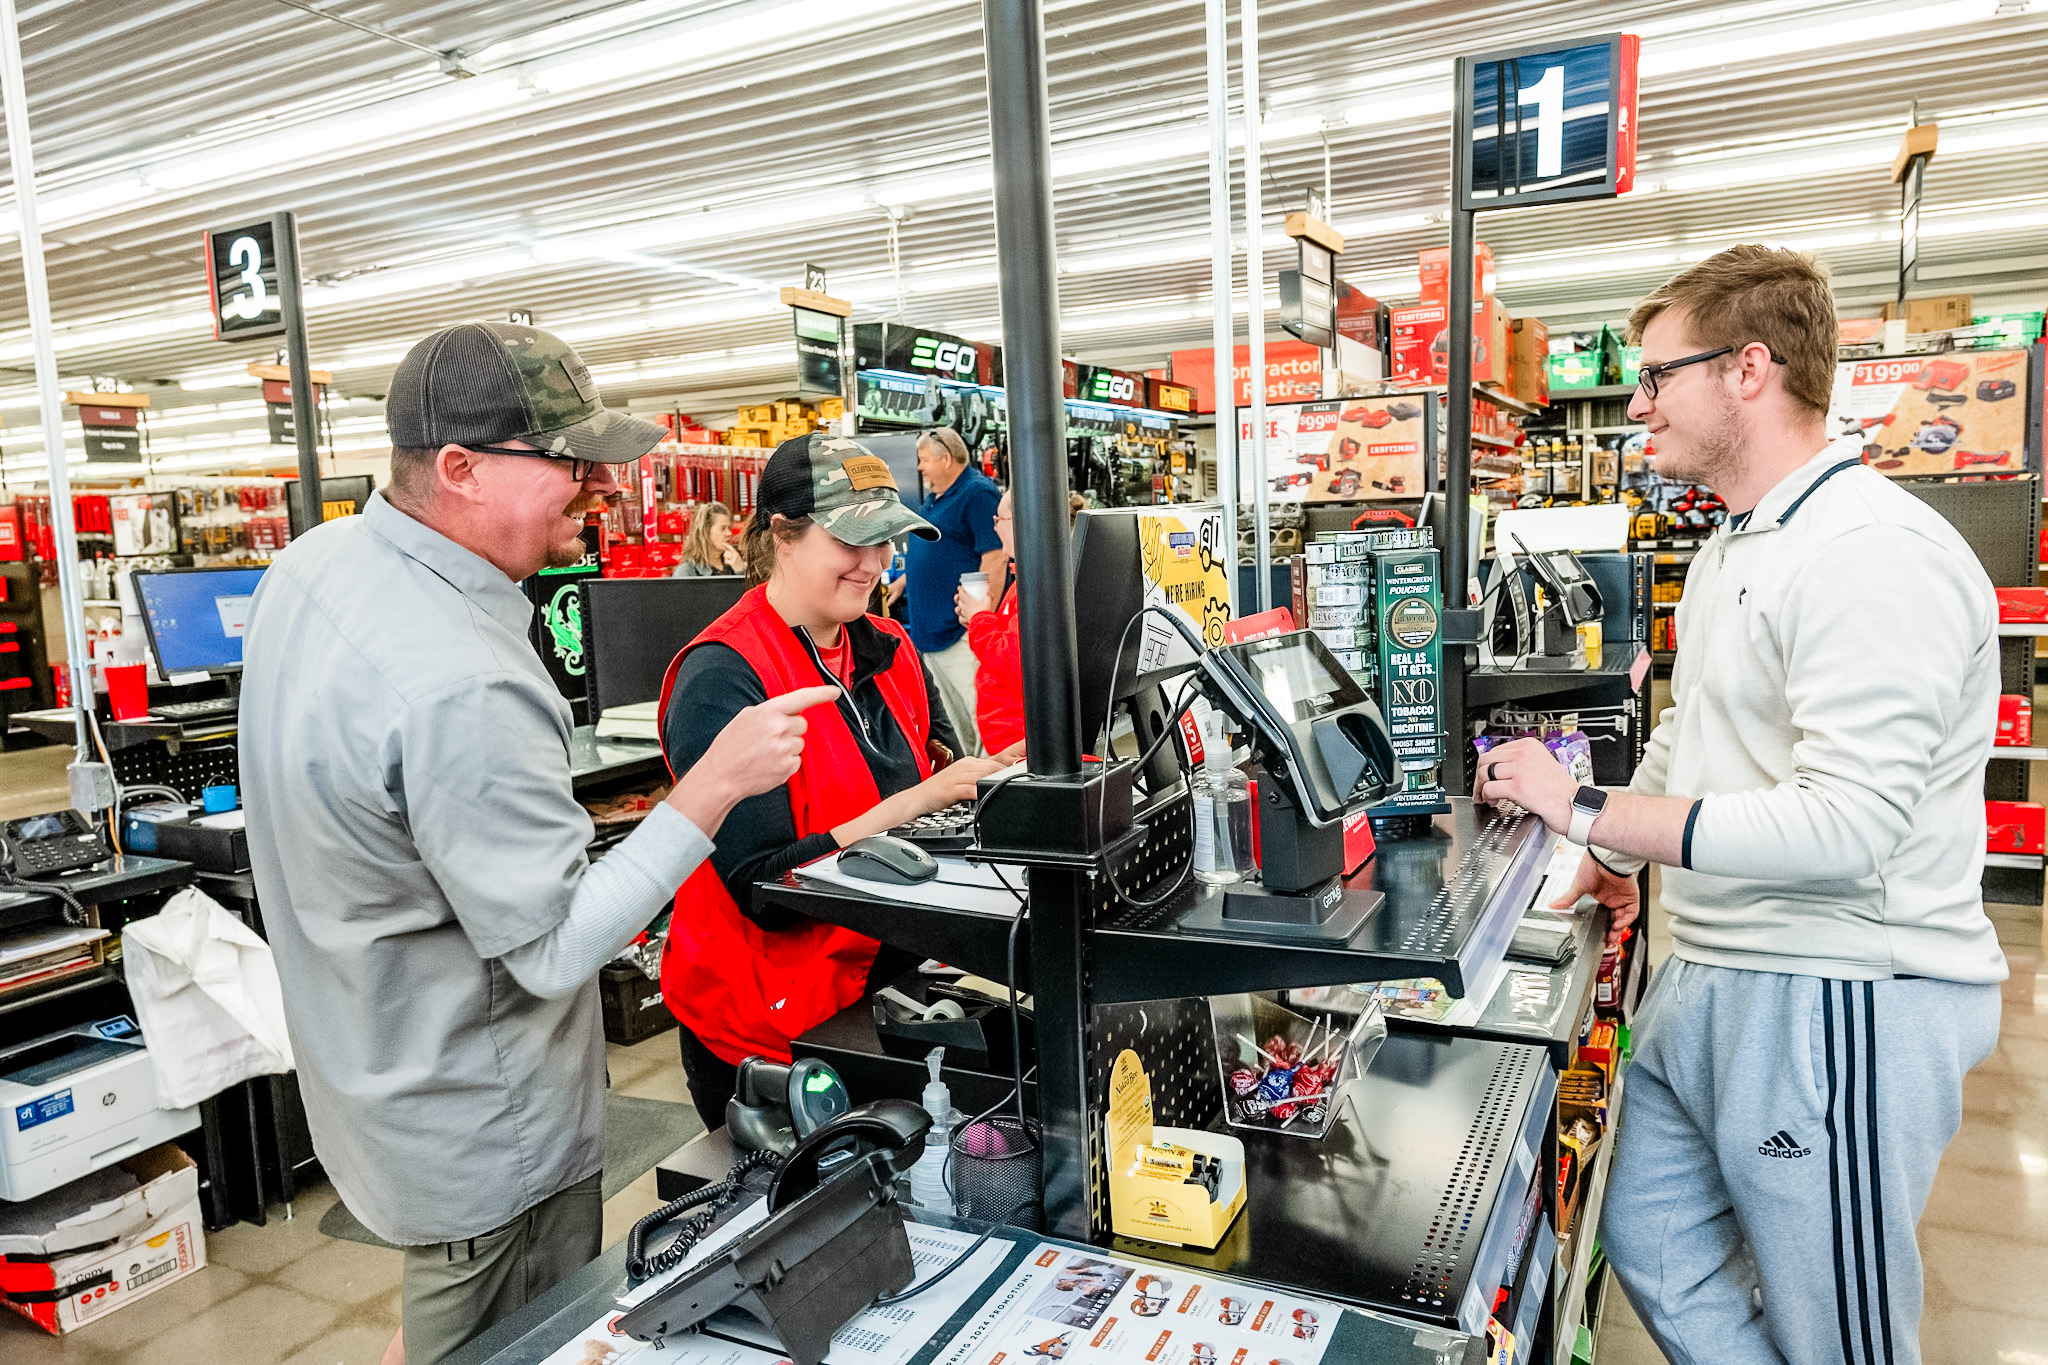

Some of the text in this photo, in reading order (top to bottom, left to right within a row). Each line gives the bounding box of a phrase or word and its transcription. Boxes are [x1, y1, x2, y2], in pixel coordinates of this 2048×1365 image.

[1518, 66, 1565, 177] 1
[229, 236, 267, 320] 3
[1396, 311, 1441, 321] CRAFTSMAN
[911, 337, 977, 374] EGO
[1094, 374, 1135, 401] EGO
[1369, 443, 1417, 456] CRAFTSMAN
[1385, 576, 1433, 585] WINTERGREEN
[1165, 581, 1206, 604] WE'RE HIRING
[1389, 584, 1431, 595] POUCHES
[1391, 652, 1427, 665] REAL AS
[1399, 665, 1409, 677] IT
[1392, 679, 1435, 705] NO
[1391, 705, 1435, 716] TOBACCO
[1392, 723, 1435, 734] NICOTINE
[1393, 739, 1436, 748] MOIST SNUFF
[1323, 886, 1343, 908] Genius
[1759, 1146, 1811, 1158] adidas
[970, 1321, 990, 1340] 2024
[989, 1273, 1033, 1319] PROMOTIONS
[1080, 1277, 1123, 1327] FATHER'S DAY
